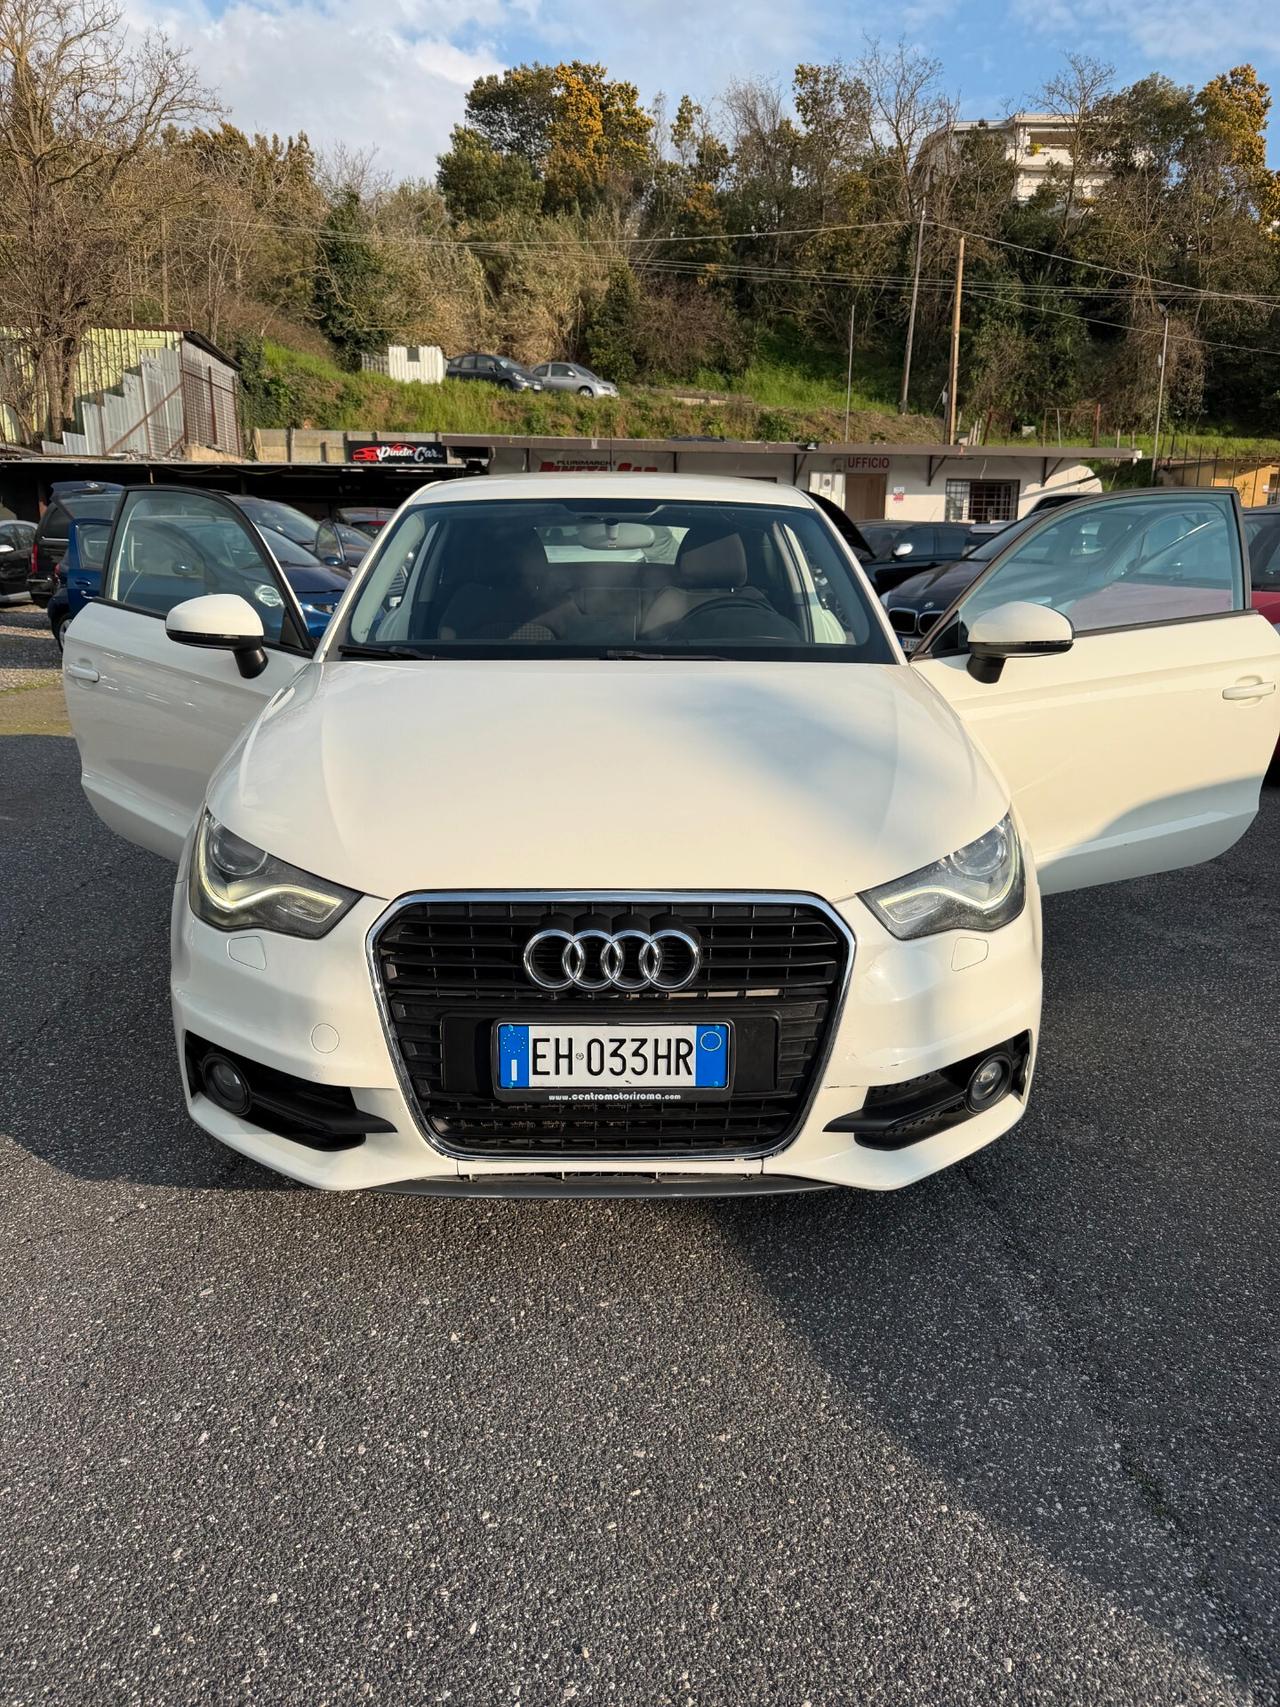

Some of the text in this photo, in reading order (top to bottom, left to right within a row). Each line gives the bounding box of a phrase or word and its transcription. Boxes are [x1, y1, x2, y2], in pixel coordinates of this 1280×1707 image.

[414, 447, 438, 462] Car
[848, 456, 890, 468] UFFICIO
[532, 1038, 694, 1076] EH 033HR
[548, 1092, 681, 1101] www.centromotoriroma.com
